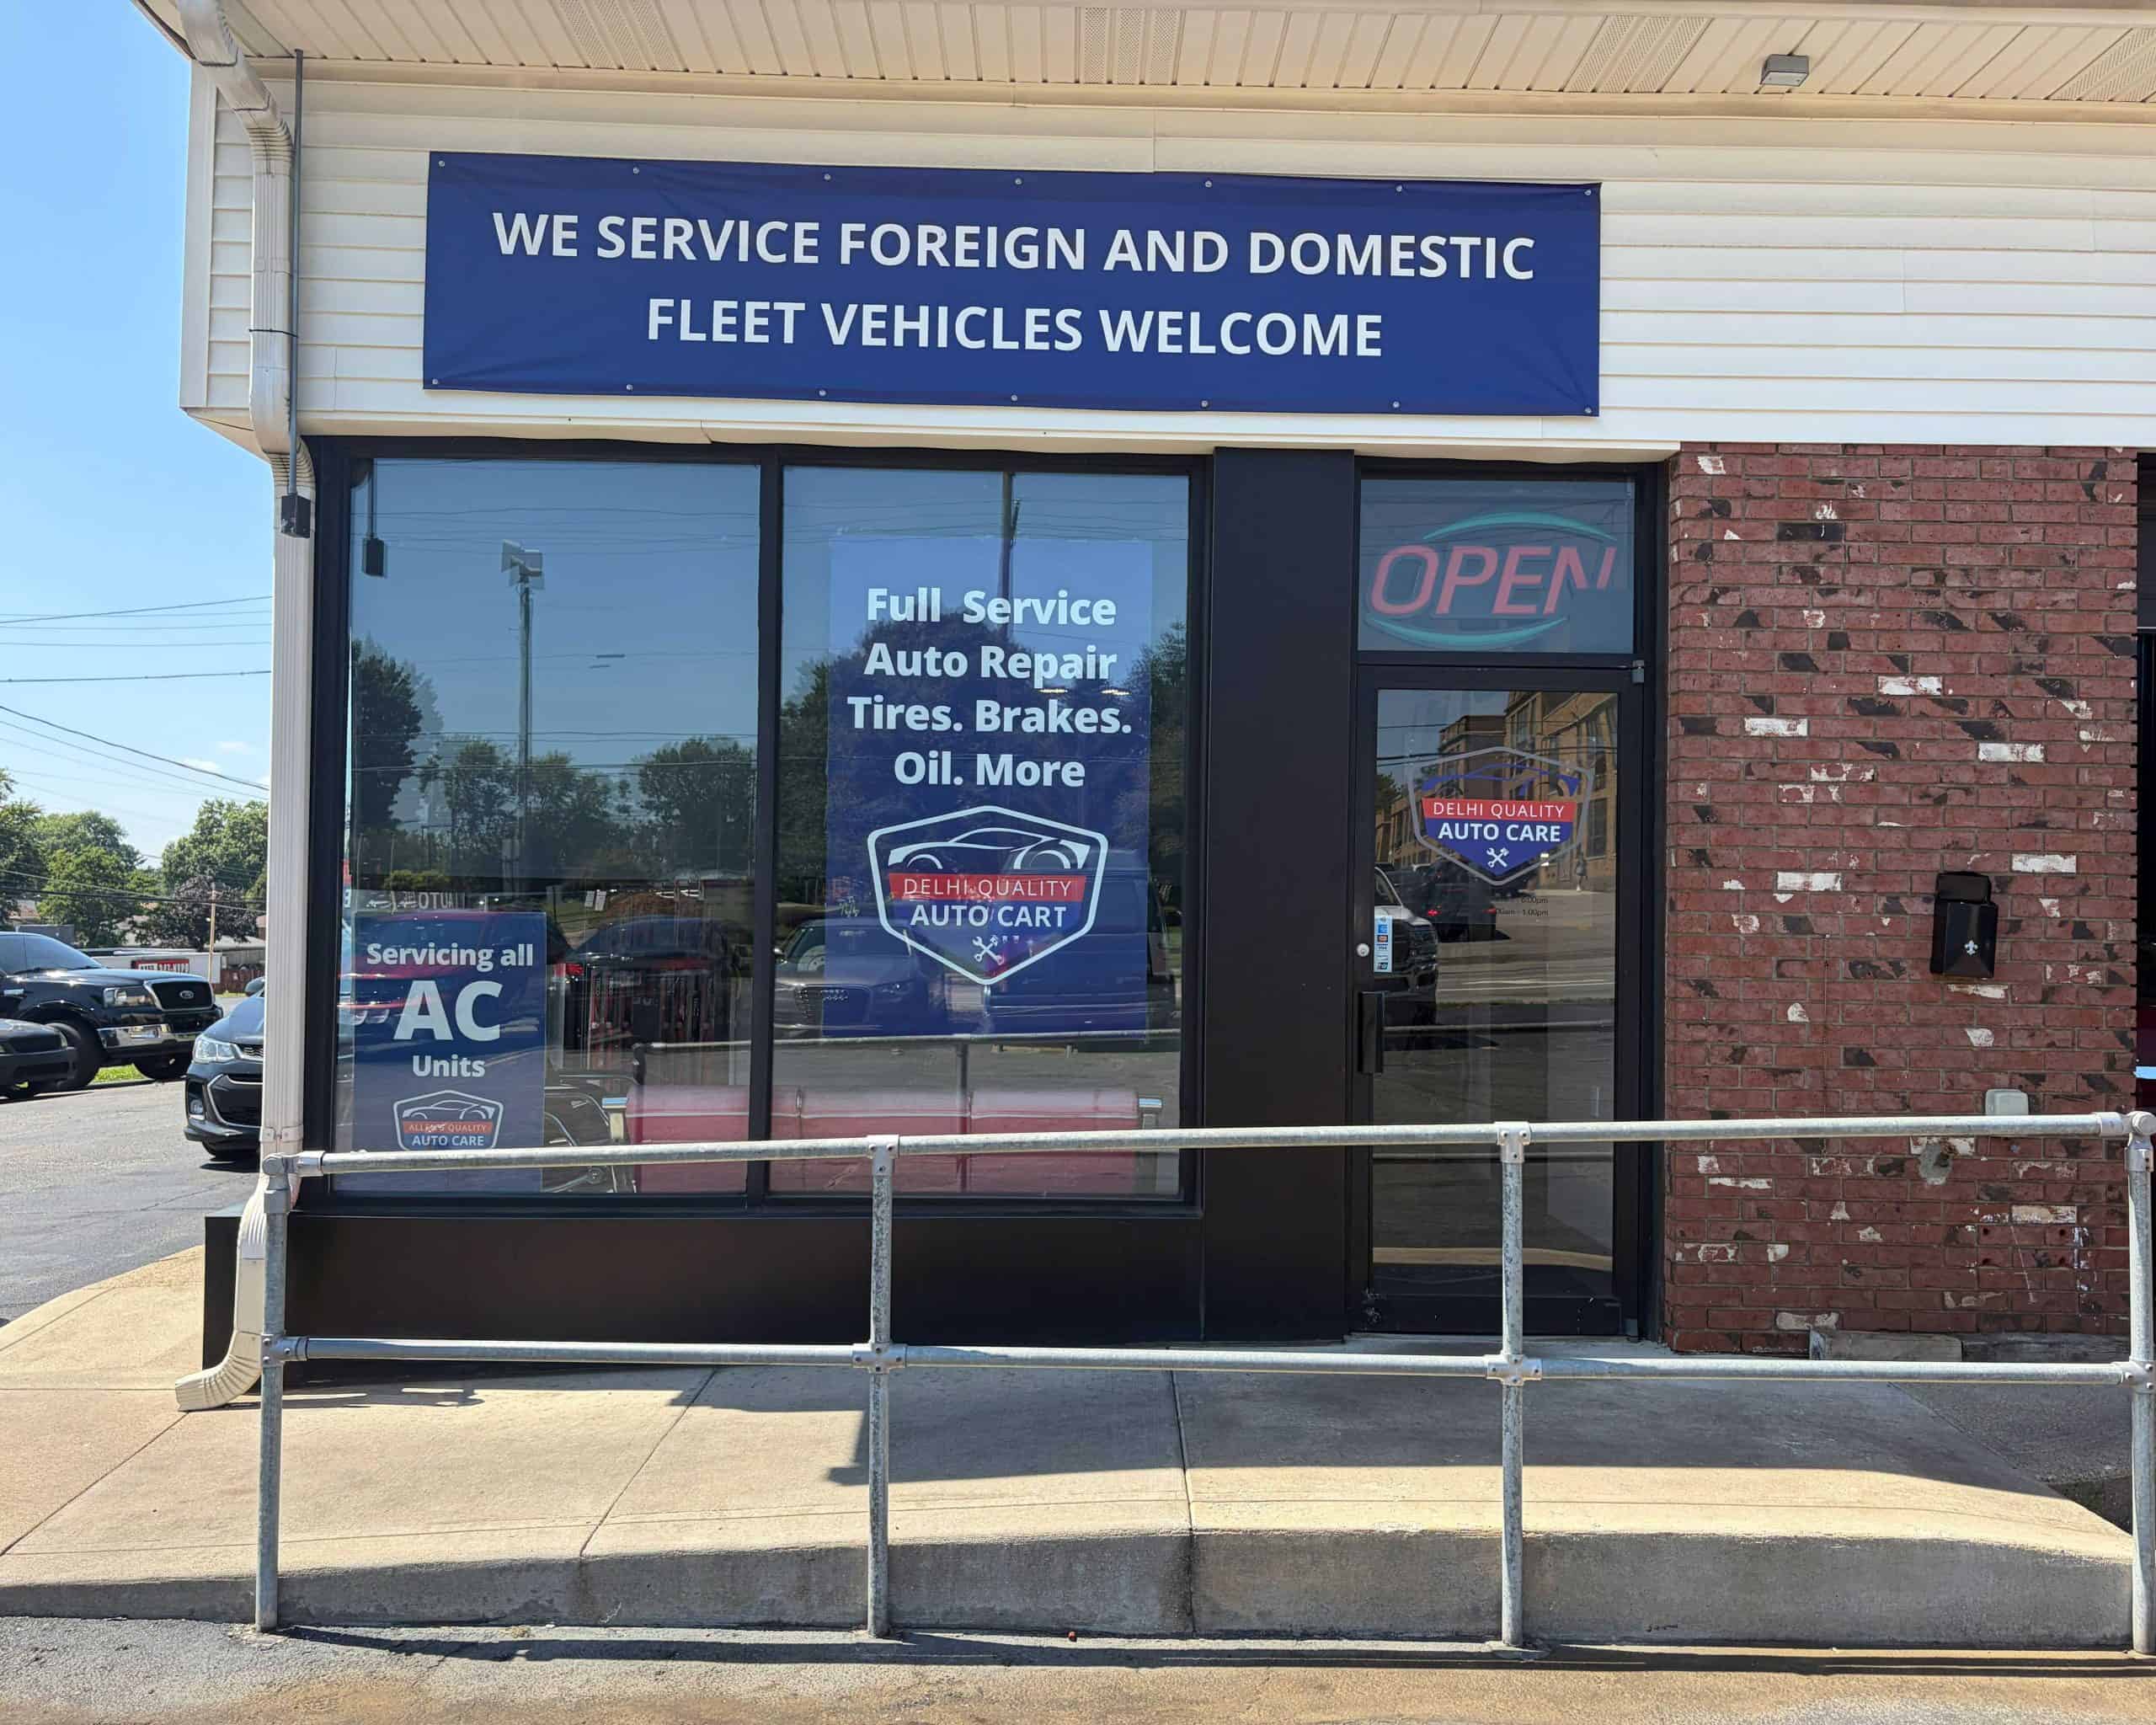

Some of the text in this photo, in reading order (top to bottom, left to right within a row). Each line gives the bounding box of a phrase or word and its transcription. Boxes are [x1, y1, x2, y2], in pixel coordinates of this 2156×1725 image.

[493, 211, 1535, 280] WE SERVICE FOREIGN AND DOMESTIC
[647, 297, 1383, 357] FLEET VEHICLES WELCOME
[1371, 544, 1618, 616] OPEN
[867, 586, 1118, 626] Full Service
[862, 642, 1118, 689] Auto Repair
[846, 694, 1133, 734] Tires. Brakes.
[894, 750, 1086, 788] Oil. More
[1433, 802, 1564, 820] DELHI QUALITY
[1438, 822, 1561, 843] AUTO CARE
[903, 879, 1072, 898] DELHI QUALITY
[910, 905, 1067, 927] AUTO CART
[366, 943, 534, 972] Servicing all
[392, 980, 504, 1042] AC
[412, 1055, 486, 1077] Units
[411, 1135, 484, 1146] AUTO CARE
